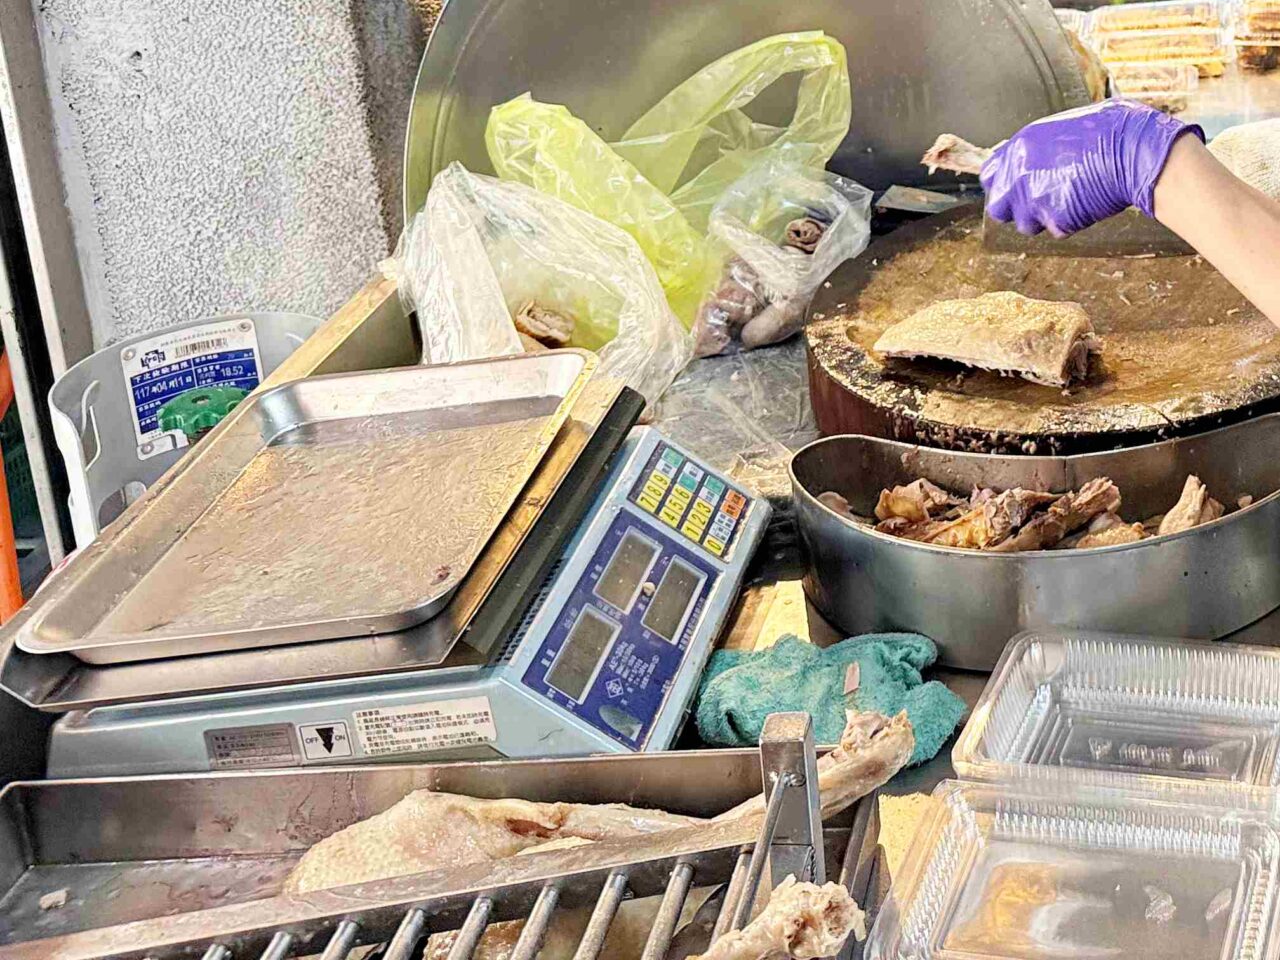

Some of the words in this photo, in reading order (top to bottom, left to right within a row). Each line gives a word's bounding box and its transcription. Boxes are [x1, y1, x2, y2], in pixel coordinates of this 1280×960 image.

[220, 365, 244, 378] 18.52
[653, 474, 668, 486] 9
[647, 485, 662, 497] 8
[674, 487, 690, 499] 6
[640, 496, 655, 509] 7
[669, 499, 684, 511] 5
[697, 501, 712, 514] 3
[664, 509, 676, 521] 4
[691, 513, 706, 526] 2
[686, 526, 700, 537] 1
[707, 538, 722, 551] 0
[334, 734, 346, 742] ON
